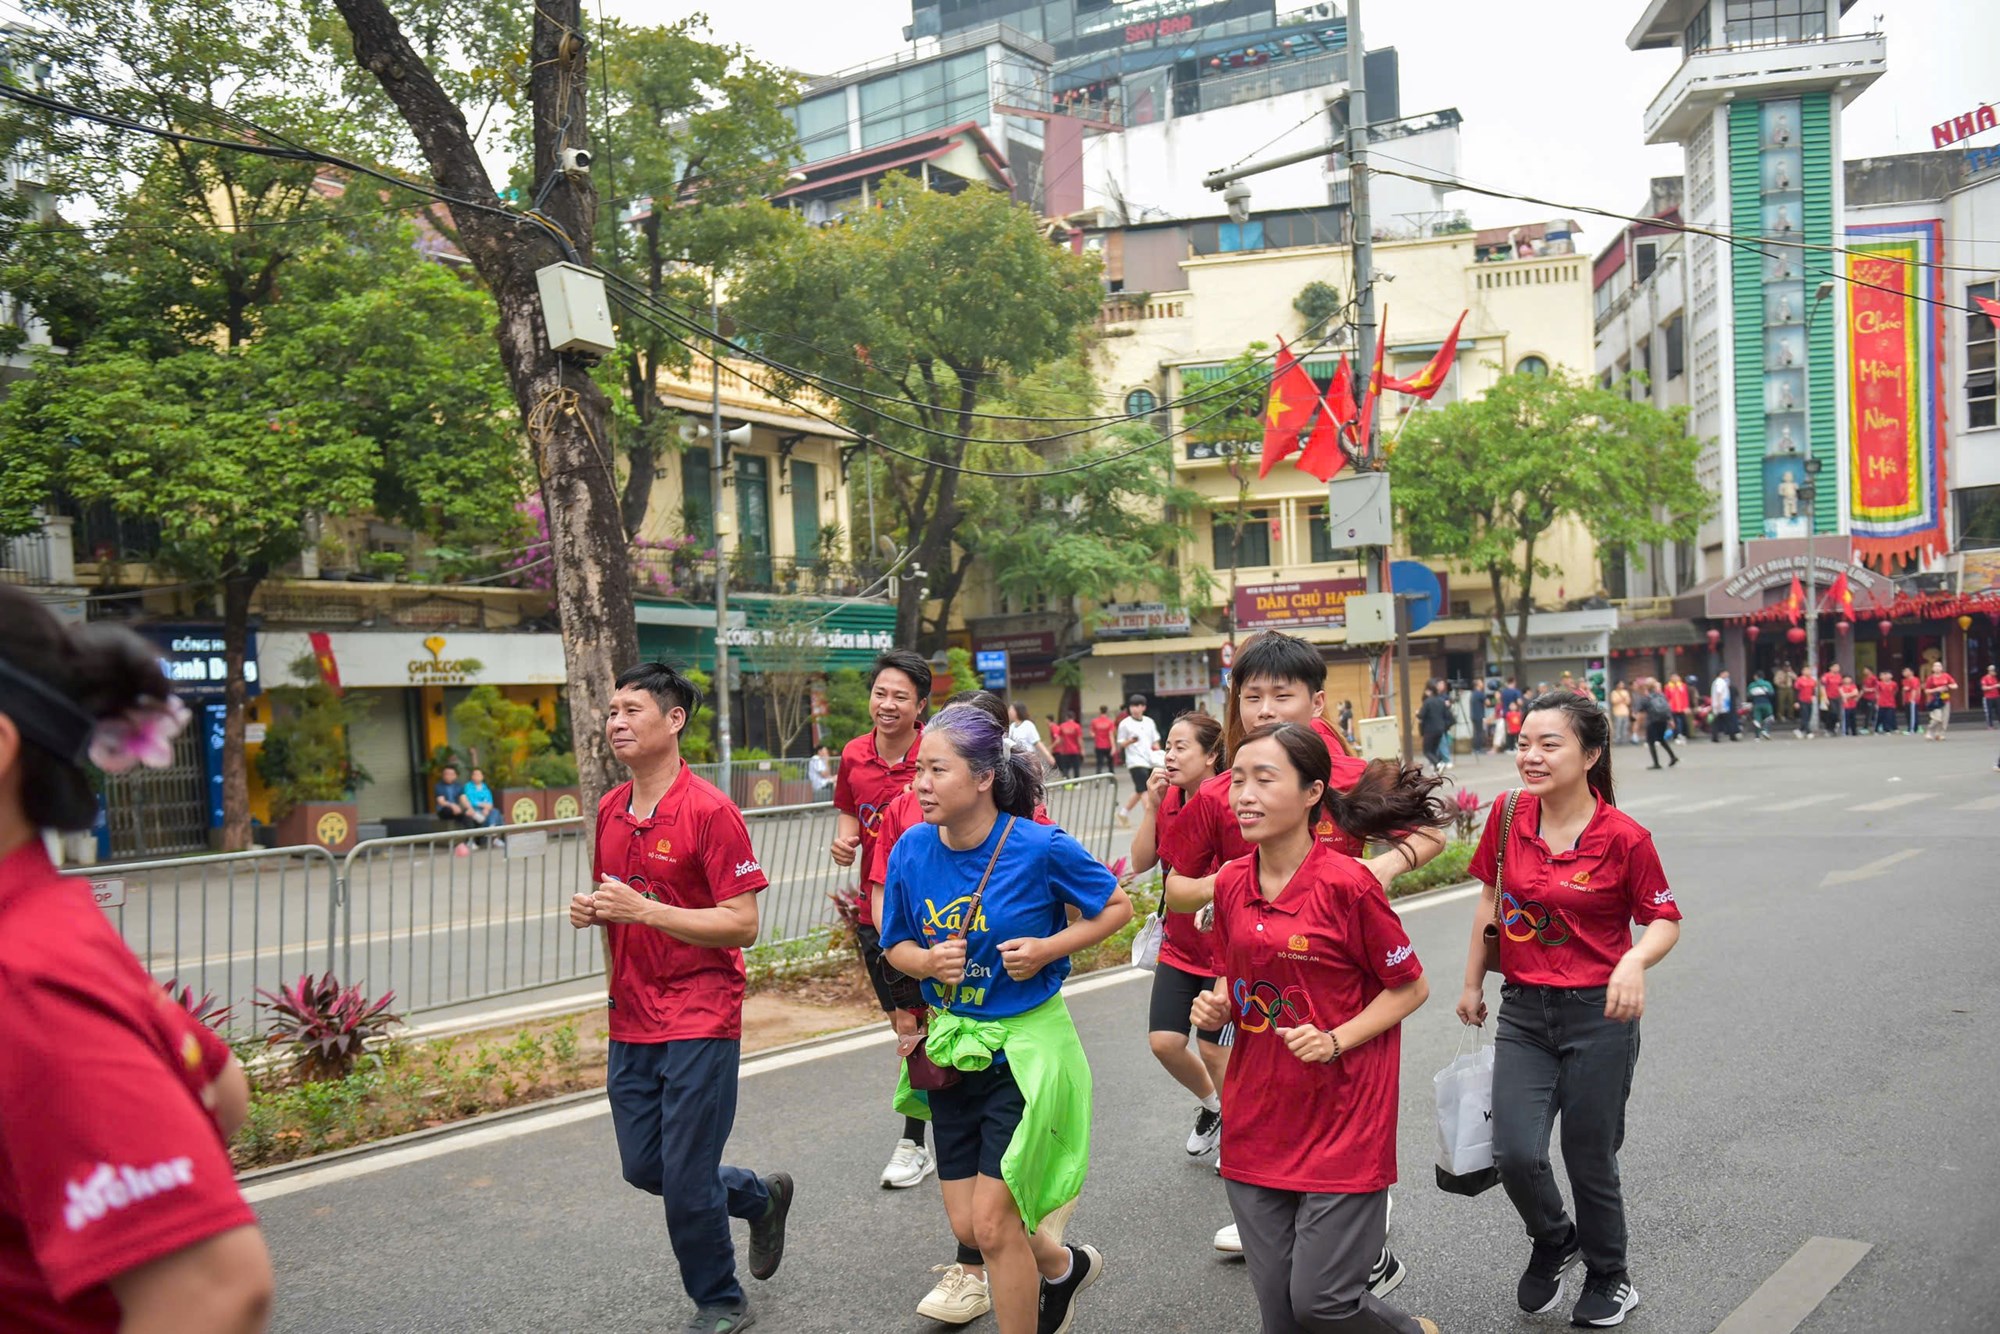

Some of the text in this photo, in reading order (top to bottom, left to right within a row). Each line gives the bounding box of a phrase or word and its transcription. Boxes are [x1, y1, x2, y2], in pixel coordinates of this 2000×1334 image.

[1125, 14, 1193, 42] SKY BAR
[1255, 593, 1288, 610] DÂN
[1291, 588, 1321, 607] CHỦ
[828, 629, 854, 648] SÁCH
[856, 630, 871, 648] HÀ
[872, 631, 893, 652] NỘI
[1288, 952, 1308, 961] CÔNG
